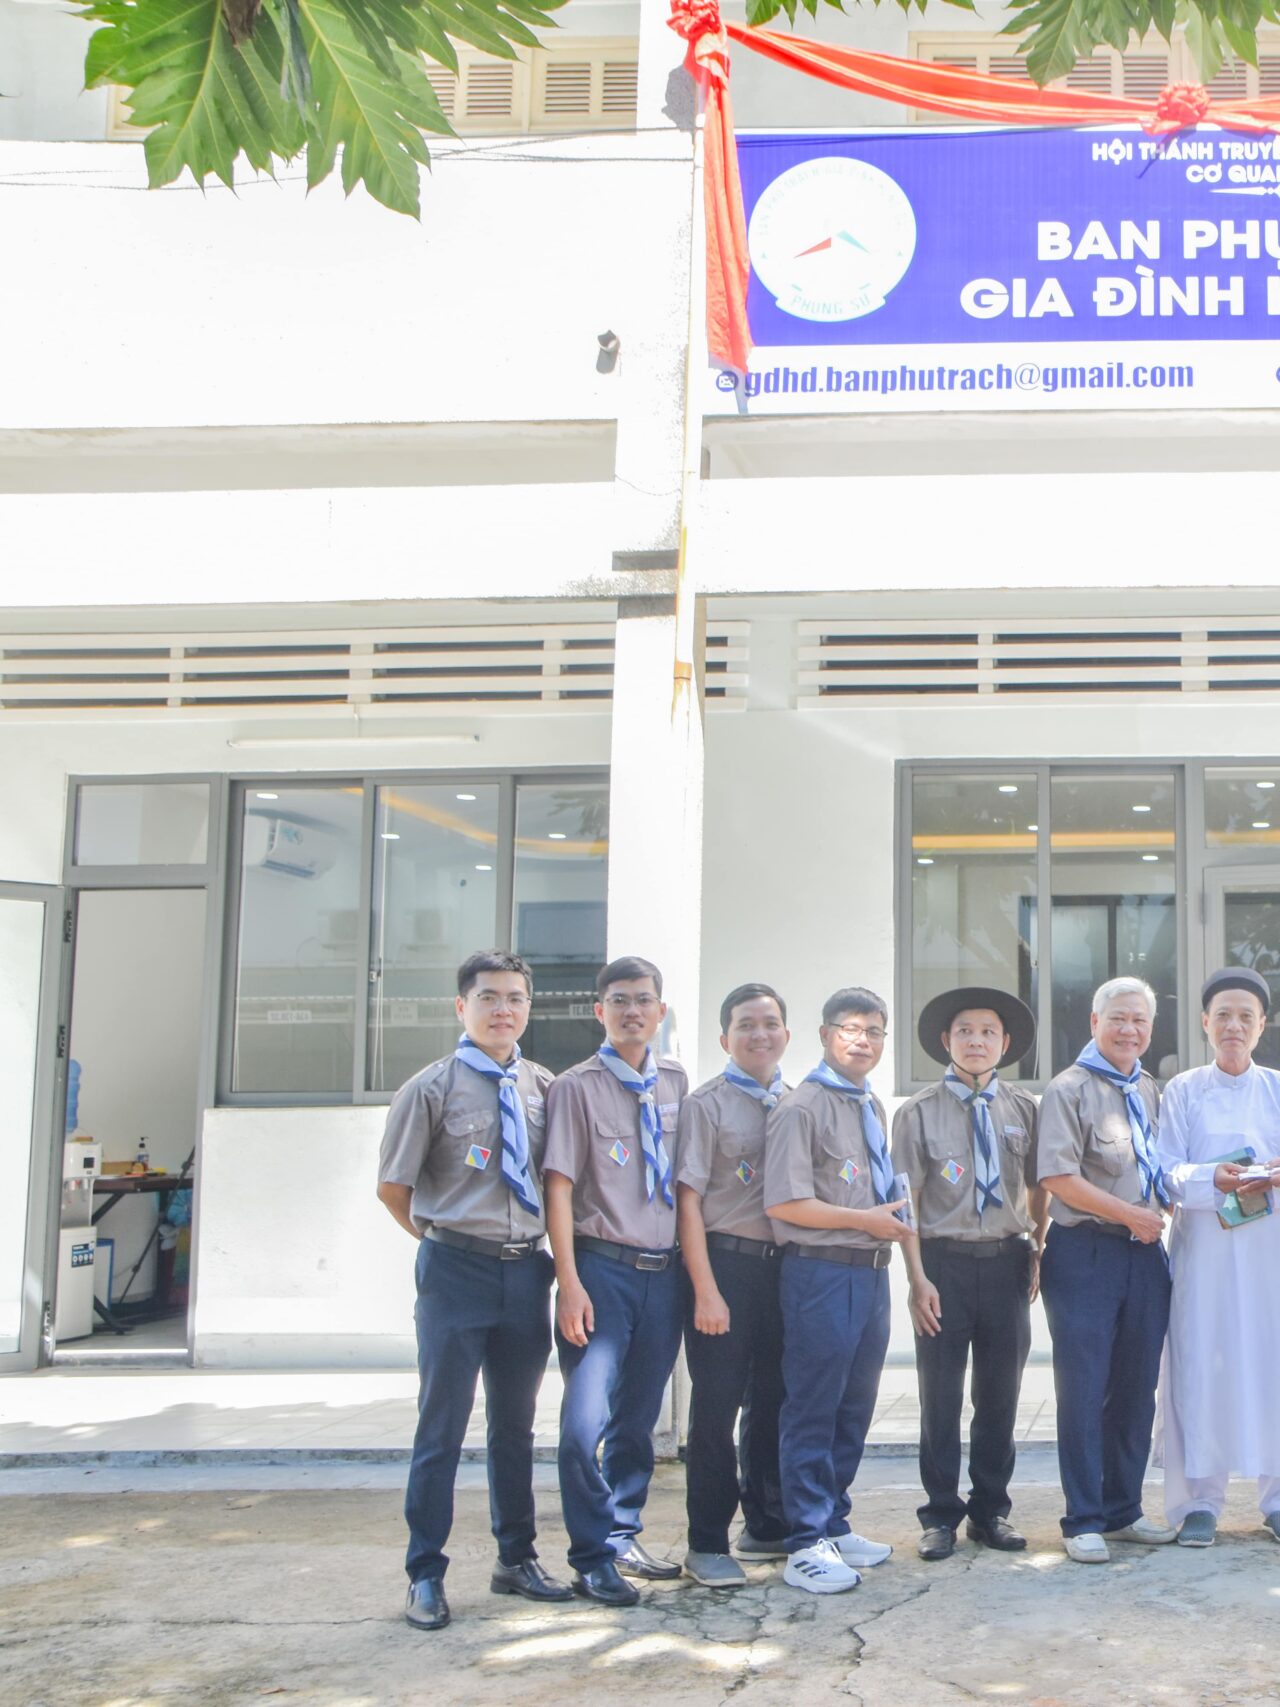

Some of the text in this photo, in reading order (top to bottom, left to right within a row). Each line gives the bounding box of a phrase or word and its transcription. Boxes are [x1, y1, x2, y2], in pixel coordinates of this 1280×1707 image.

[1092, 138, 1133, 163] HỘI
[1138, 137, 1214, 161] THÁNH
[1185, 164, 1223, 183] CƠ
[1037, 219, 1160, 260] BAN
[959, 277, 1074, 319] GIA
[1092, 264, 1244, 317] ĐÌNH
[744, 361, 1194, 397] gdhd.banphutrach@gmail.com
